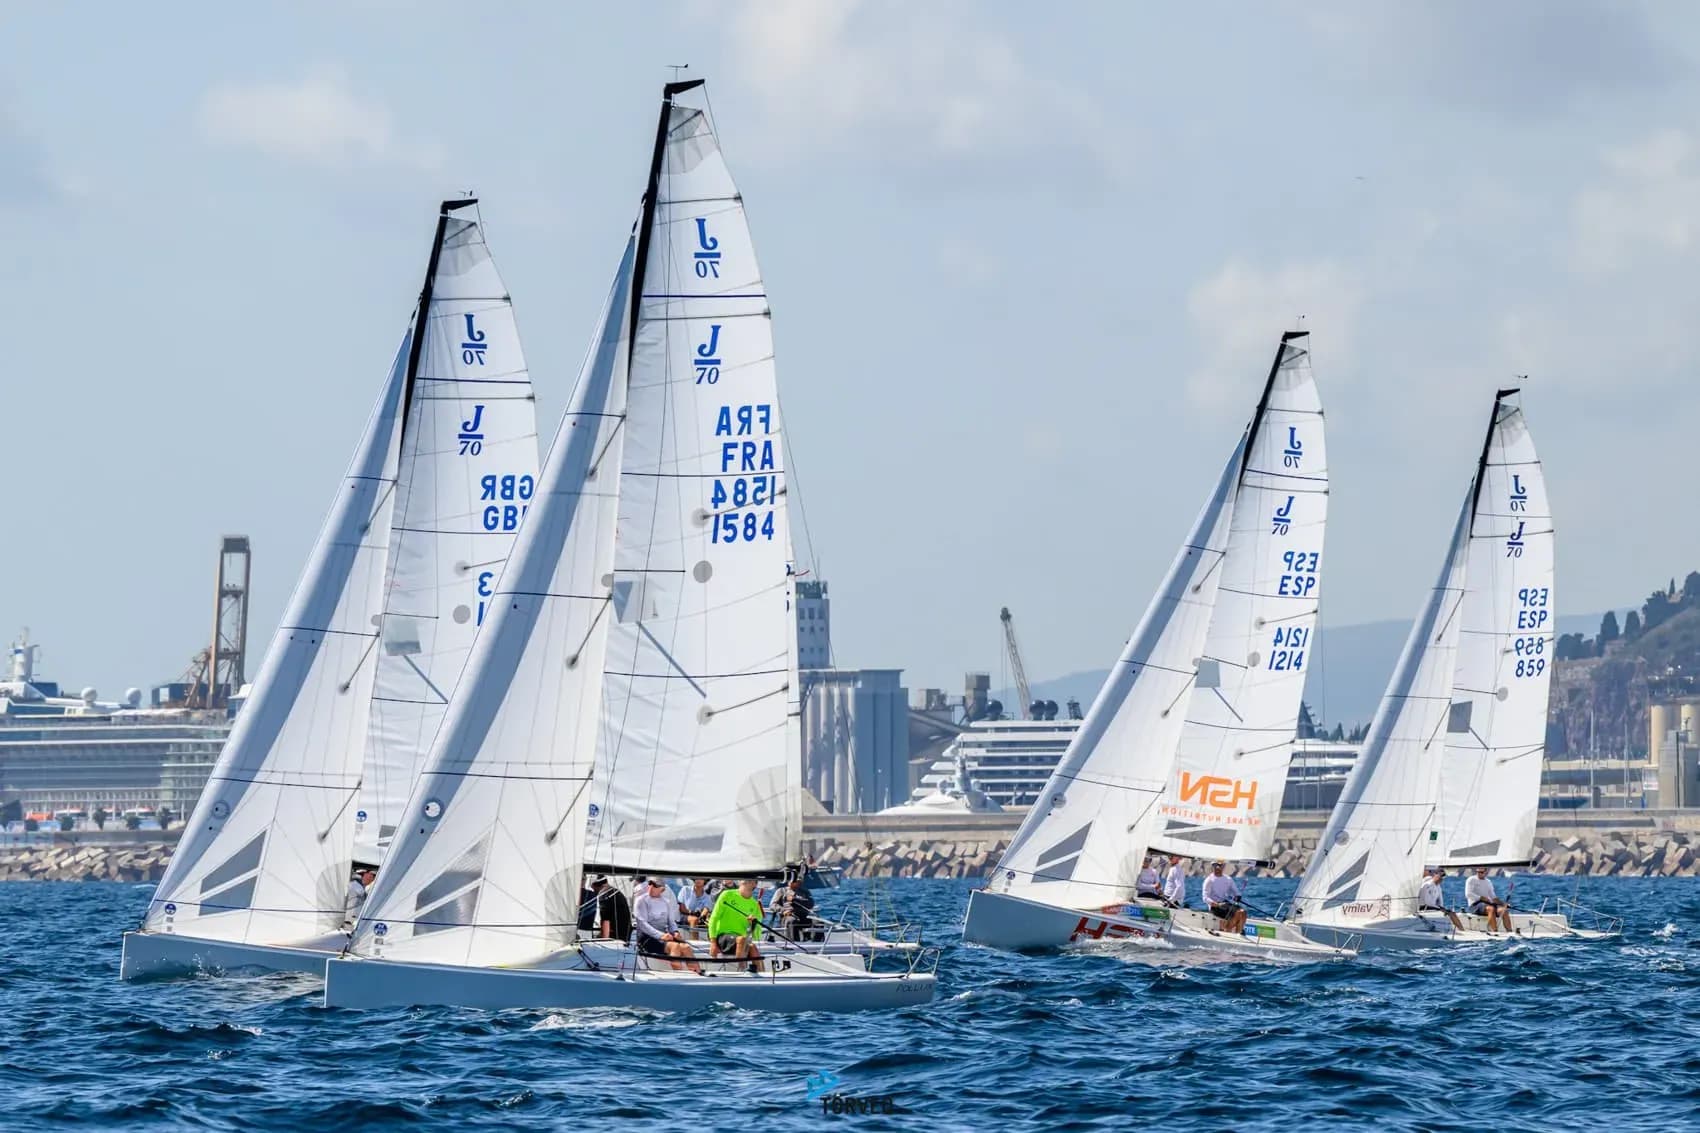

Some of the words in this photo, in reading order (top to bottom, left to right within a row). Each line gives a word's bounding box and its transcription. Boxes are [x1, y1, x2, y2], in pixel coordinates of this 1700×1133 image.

[697, 324, 721, 358] J
[695, 366, 720, 385] 70
[461, 405, 485, 433] J
[457, 440, 483, 458] 70
[721, 440, 775, 473] FRA
[1276, 495, 1295, 518] J
[712, 511, 775, 545] 1584
[1271, 522, 1289, 537] 70
[1509, 521, 1526, 541] J
[1506, 546, 1523, 558] 70
[1278, 575, 1316, 597] ESP
[1517, 610, 1549, 630] ESP
[1268, 650, 1304, 672] 1214
[1514, 658, 1546, 678] 859
